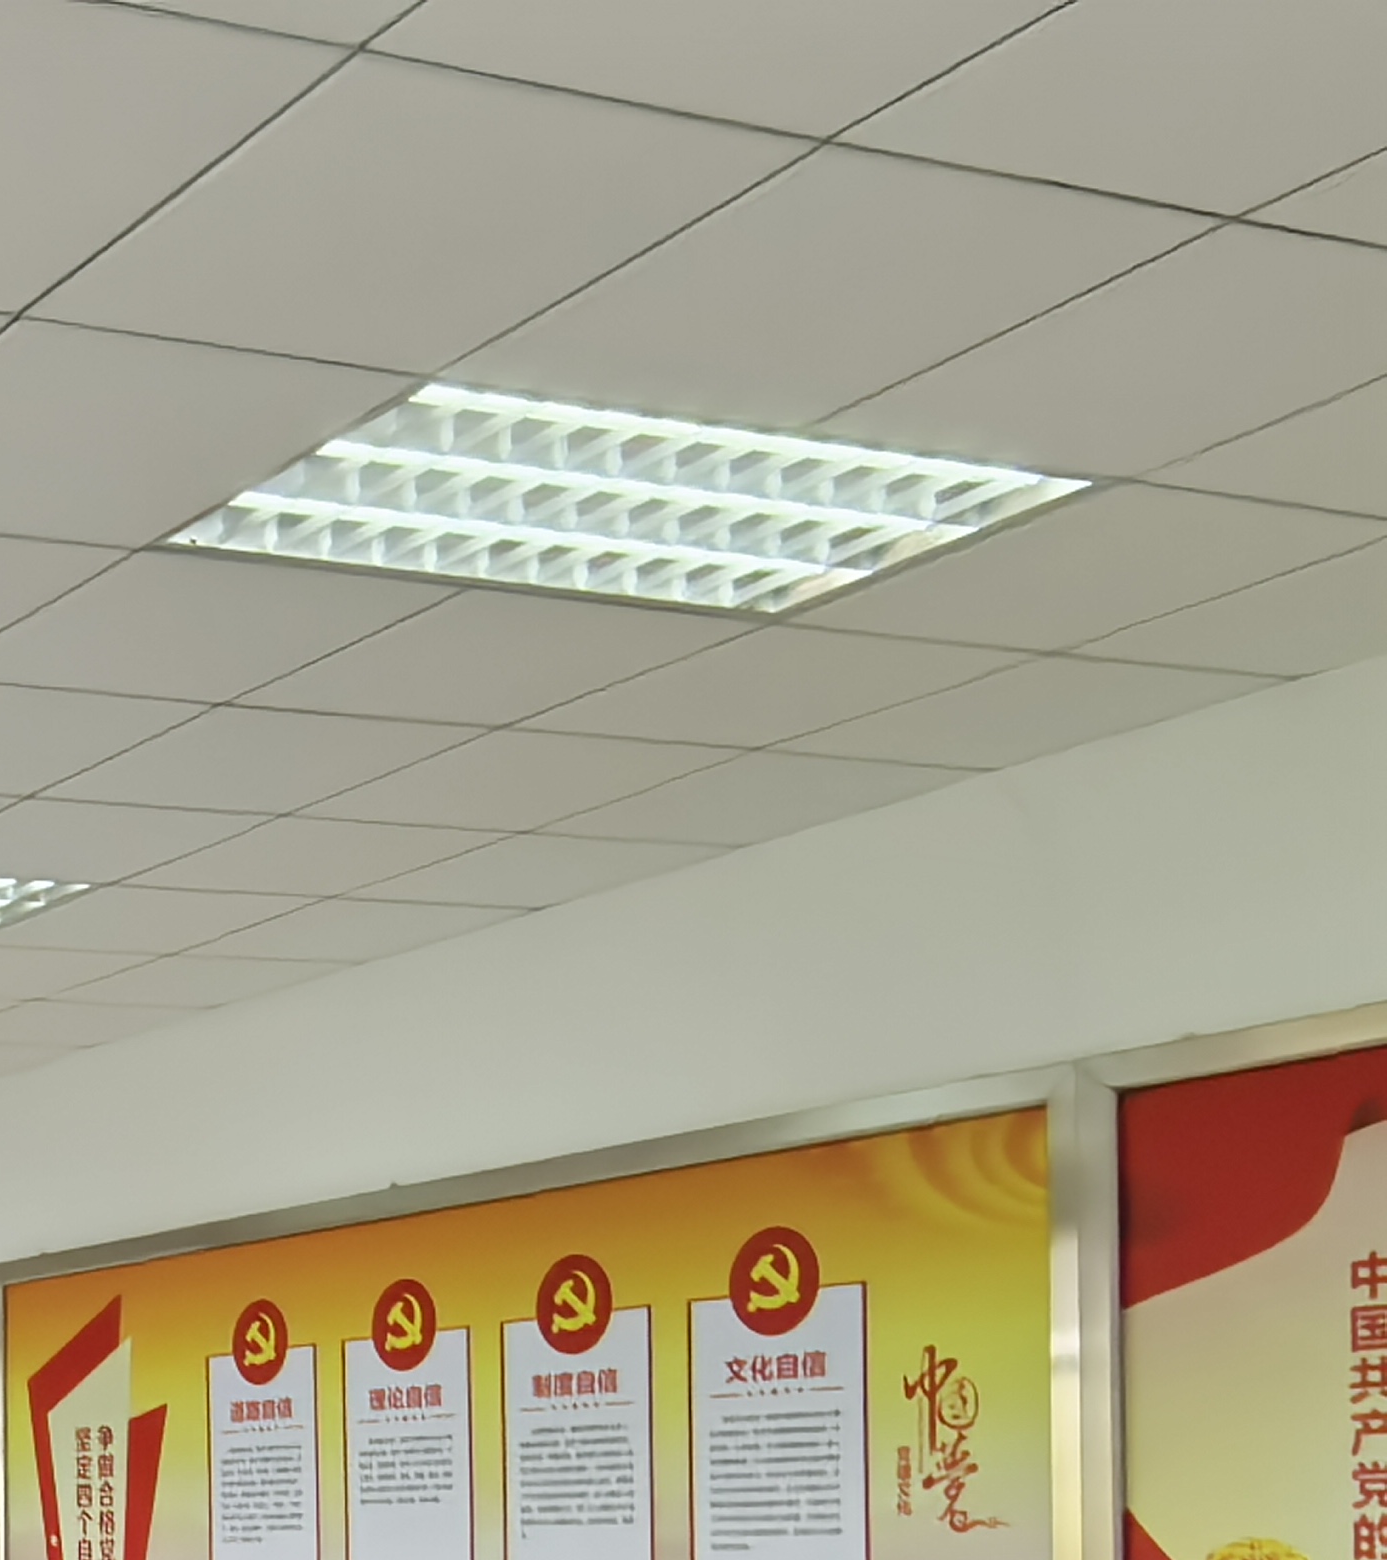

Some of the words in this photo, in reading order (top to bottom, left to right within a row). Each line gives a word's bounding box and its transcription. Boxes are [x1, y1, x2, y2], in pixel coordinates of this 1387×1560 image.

[531, 1367, 618, 1399] 制度自信
[725, 1350, 827, 1384] 文化自信
